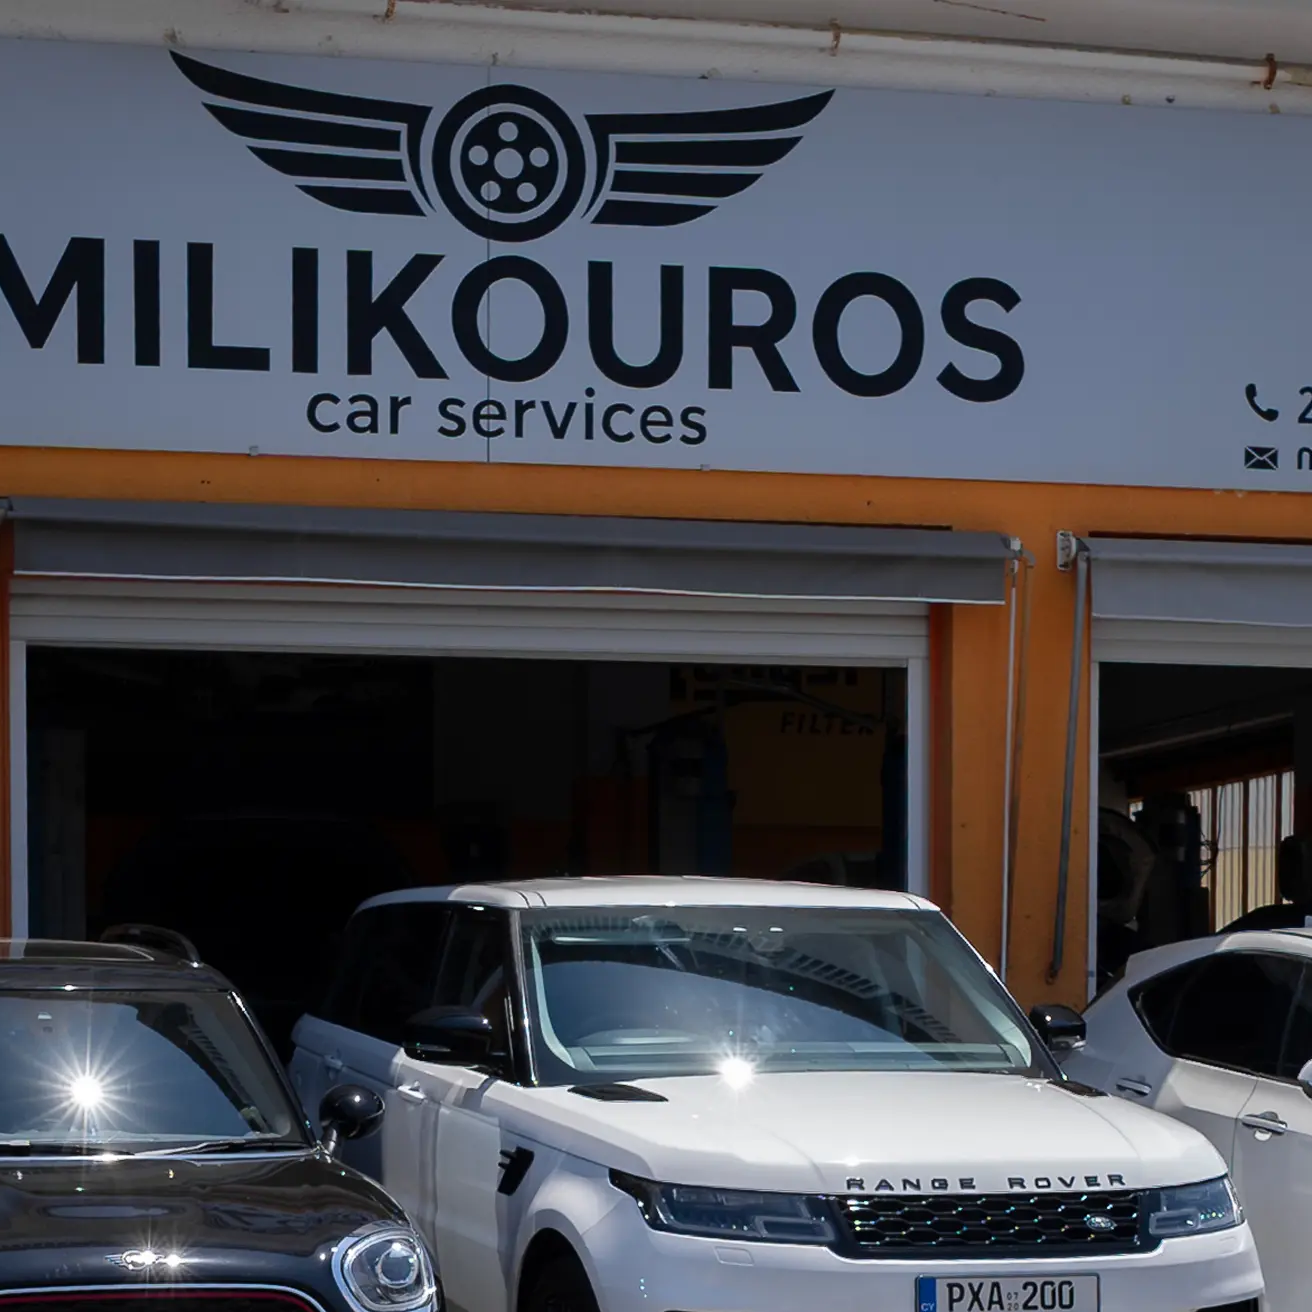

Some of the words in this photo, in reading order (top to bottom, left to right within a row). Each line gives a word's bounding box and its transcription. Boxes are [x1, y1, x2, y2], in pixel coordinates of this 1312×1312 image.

[306, 391, 412, 435] car
[437, 388, 708, 445] services
[846, 1177, 976, 1192] RANGE
[1007, 1173, 1127, 1190] ROVER
[920, 1302, 935, 1312] CY
[946, 1281, 1004, 1312] PXA
[1021, 1280, 1075, 1311] 200
